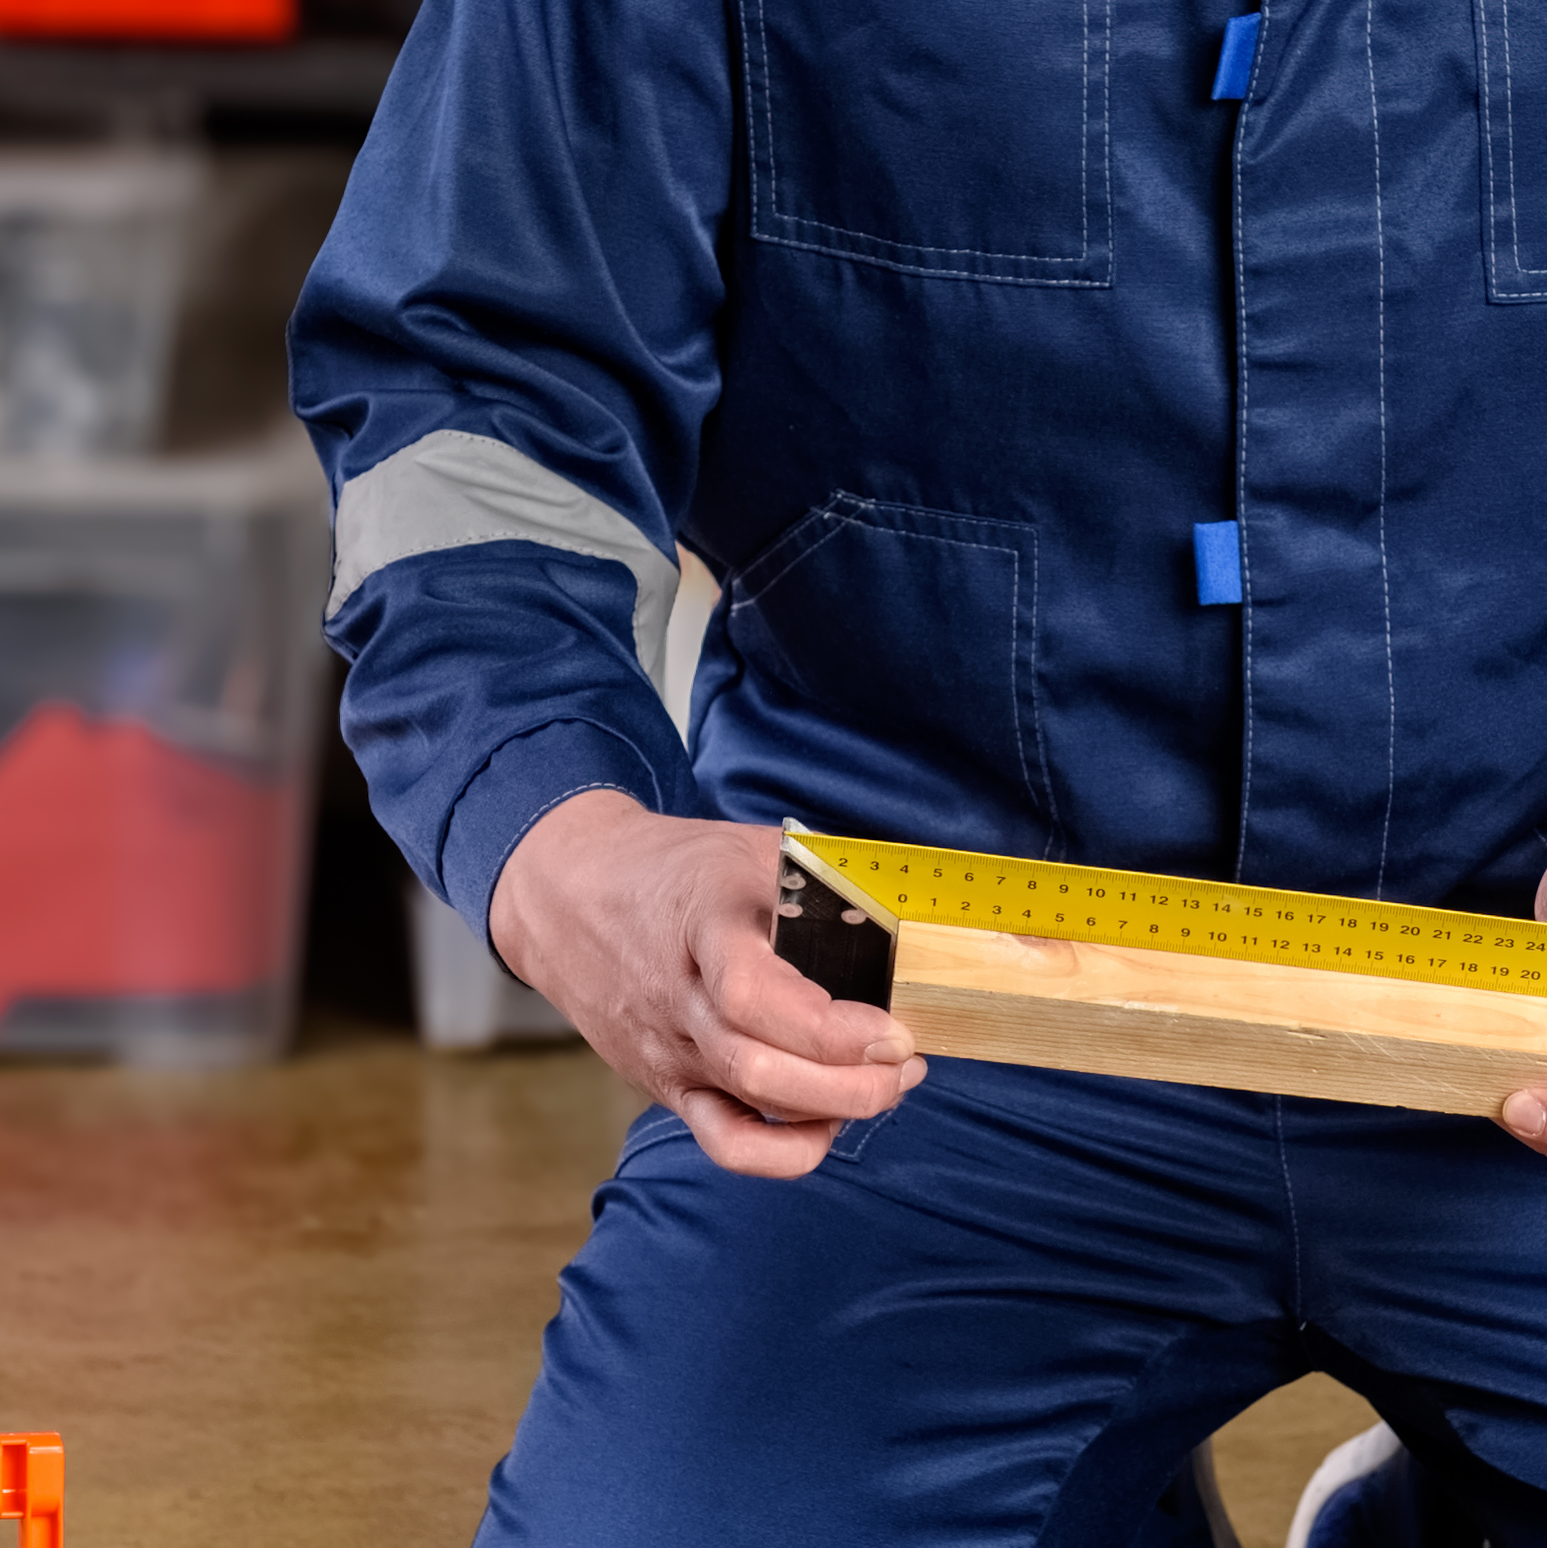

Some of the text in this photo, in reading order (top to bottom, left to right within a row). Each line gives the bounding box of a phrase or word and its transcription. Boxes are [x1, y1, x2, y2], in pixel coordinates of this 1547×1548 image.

[838, 857, 849, 868] 2
[869, 860, 880, 871] 3
[899, 864, 909, 874] 4
[933, 868, 943, 878] 5
[964, 872, 975, 882] 6
[996, 875, 1007, 886] 7
[1027, 880, 1037, 890] 8
[1059, 884, 1069, 894] 9
[1085, 887, 1106, 898] 10
[1119, 891, 1137, 902] 11
[1149, 894, 1169, 906] 12
[1181, 898, 1200, 910] 13
[1212, 902, 1231, 913] 14
[1244, 906, 1263, 918] 15
[1275, 910, 1295, 921] 16
[1308, 913, 1327, 924] 17
[1338, 917, 1358, 929] 18
[1370, 921, 1389, 932] 19
[1399, 925, 1421, 936] 20
[1432, 929, 1451, 940] 21
[1462, 933, 1484, 945] 22
[1494, 937, 1515, 949] 23
[1525, 941, 1546, 952] 24
[897, 893, 908, 904] 0
[930, 897, 937, 907] 1
[960, 901, 971, 911] 2
[991, 905, 1002, 915] 3
[1021, 909, 1032, 919] 4
[1054, 912, 1065, 923] 5
[1086, 916, 1096, 927] 6
[1118, 920, 1128, 930] 7
[1149, 924, 1159, 934] 8
[1180, 927, 1191, 938] 9
[1207, 931, 1227, 942] 10
[1240, 935, 1258, 946] 11
[1271, 939, 1290, 950] 12
[1302, 942, 1321, 953] 13
[1334, 946, 1352, 957] 14
[1366, 949, 1384, 961] 15
[1396, 953, 1415, 965] 16
[1427, 957, 1447, 968] 17
[1459, 962, 1478, 973] 18
[1490, 966, 1510, 977] 19
[1520, 969, 1541, 981] 20
